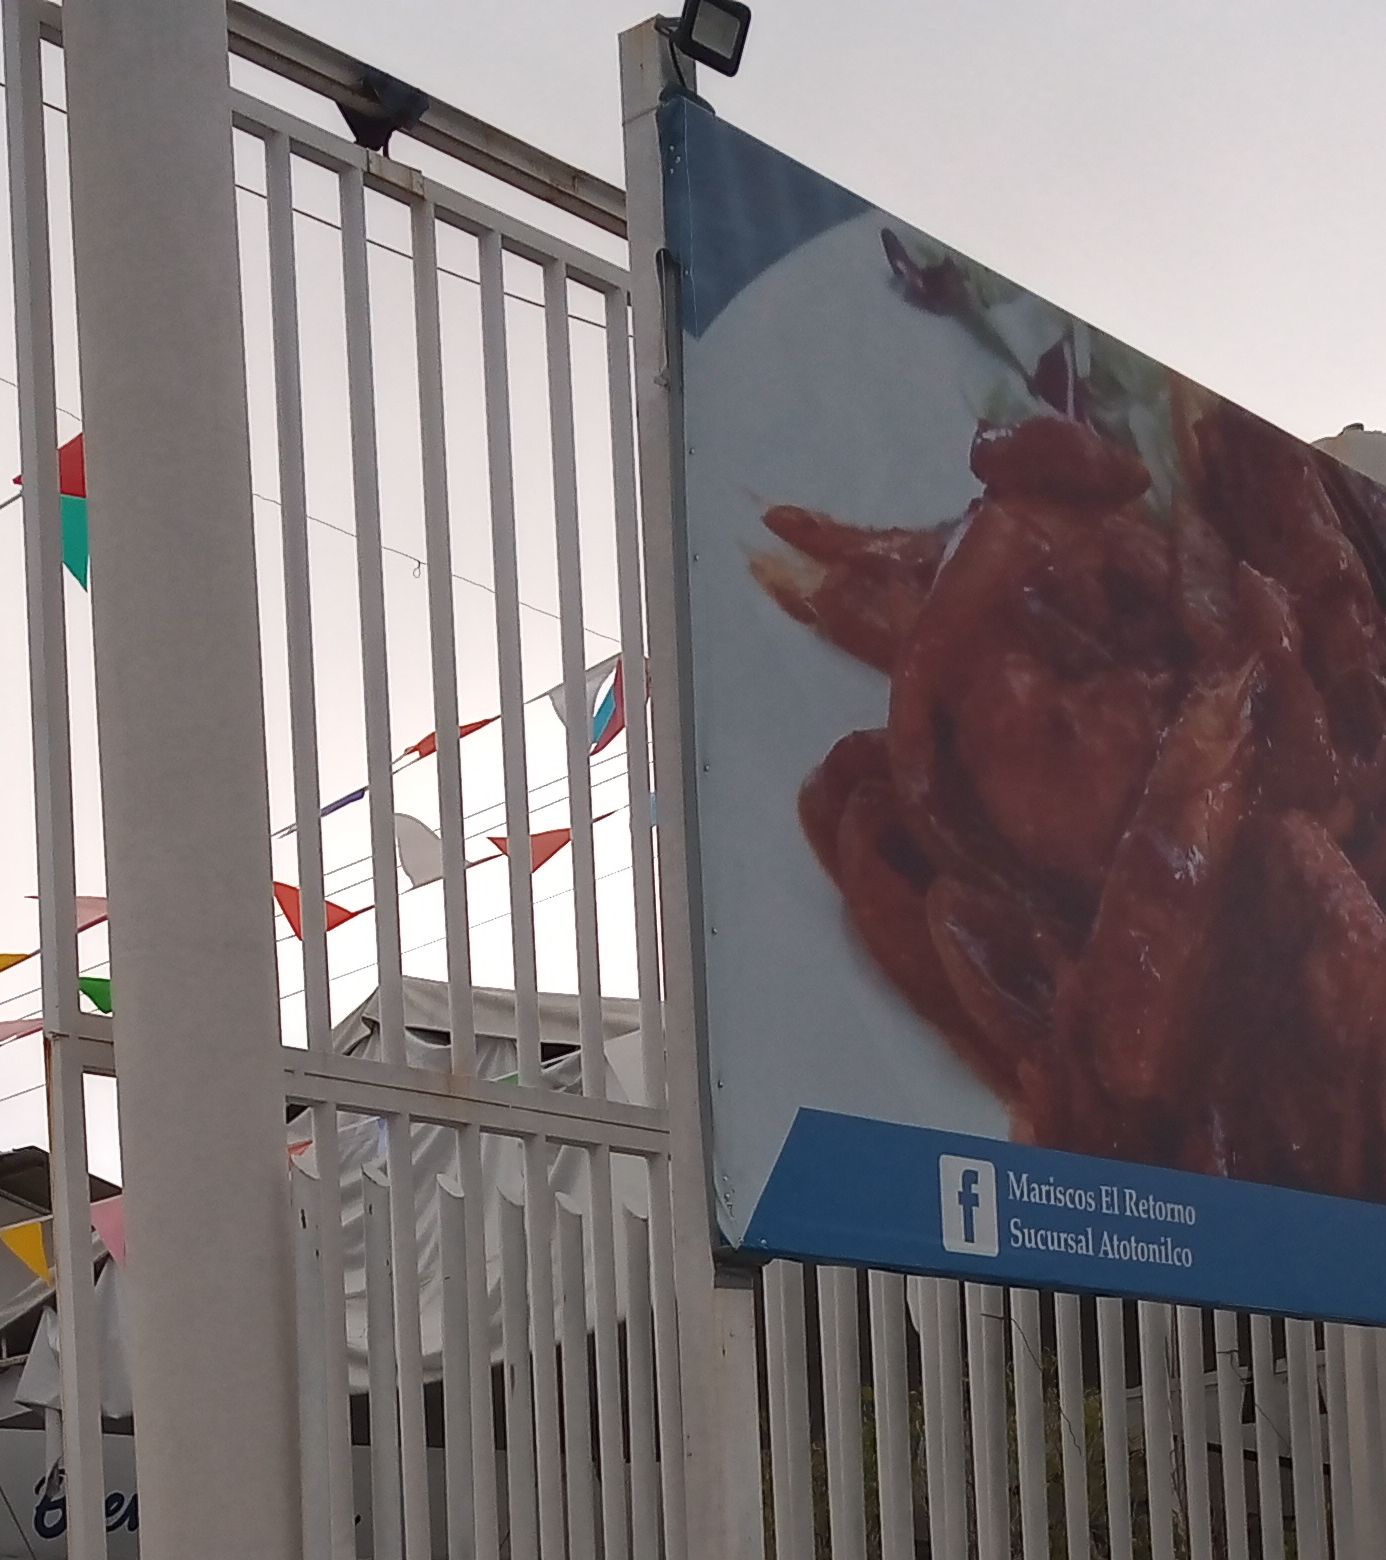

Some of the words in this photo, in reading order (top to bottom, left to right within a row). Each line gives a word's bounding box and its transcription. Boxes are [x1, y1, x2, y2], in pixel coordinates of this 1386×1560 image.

[1007, 1171, 1095, 1213] Mariscos
[1100, 1185, 1118, 1215] El
[1123, 1188, 1196, 1226] Retorno
[1010, 1218, 1094, 1255] Sucursal
[1099, 1230, 1193, 1267] Atotonilco
